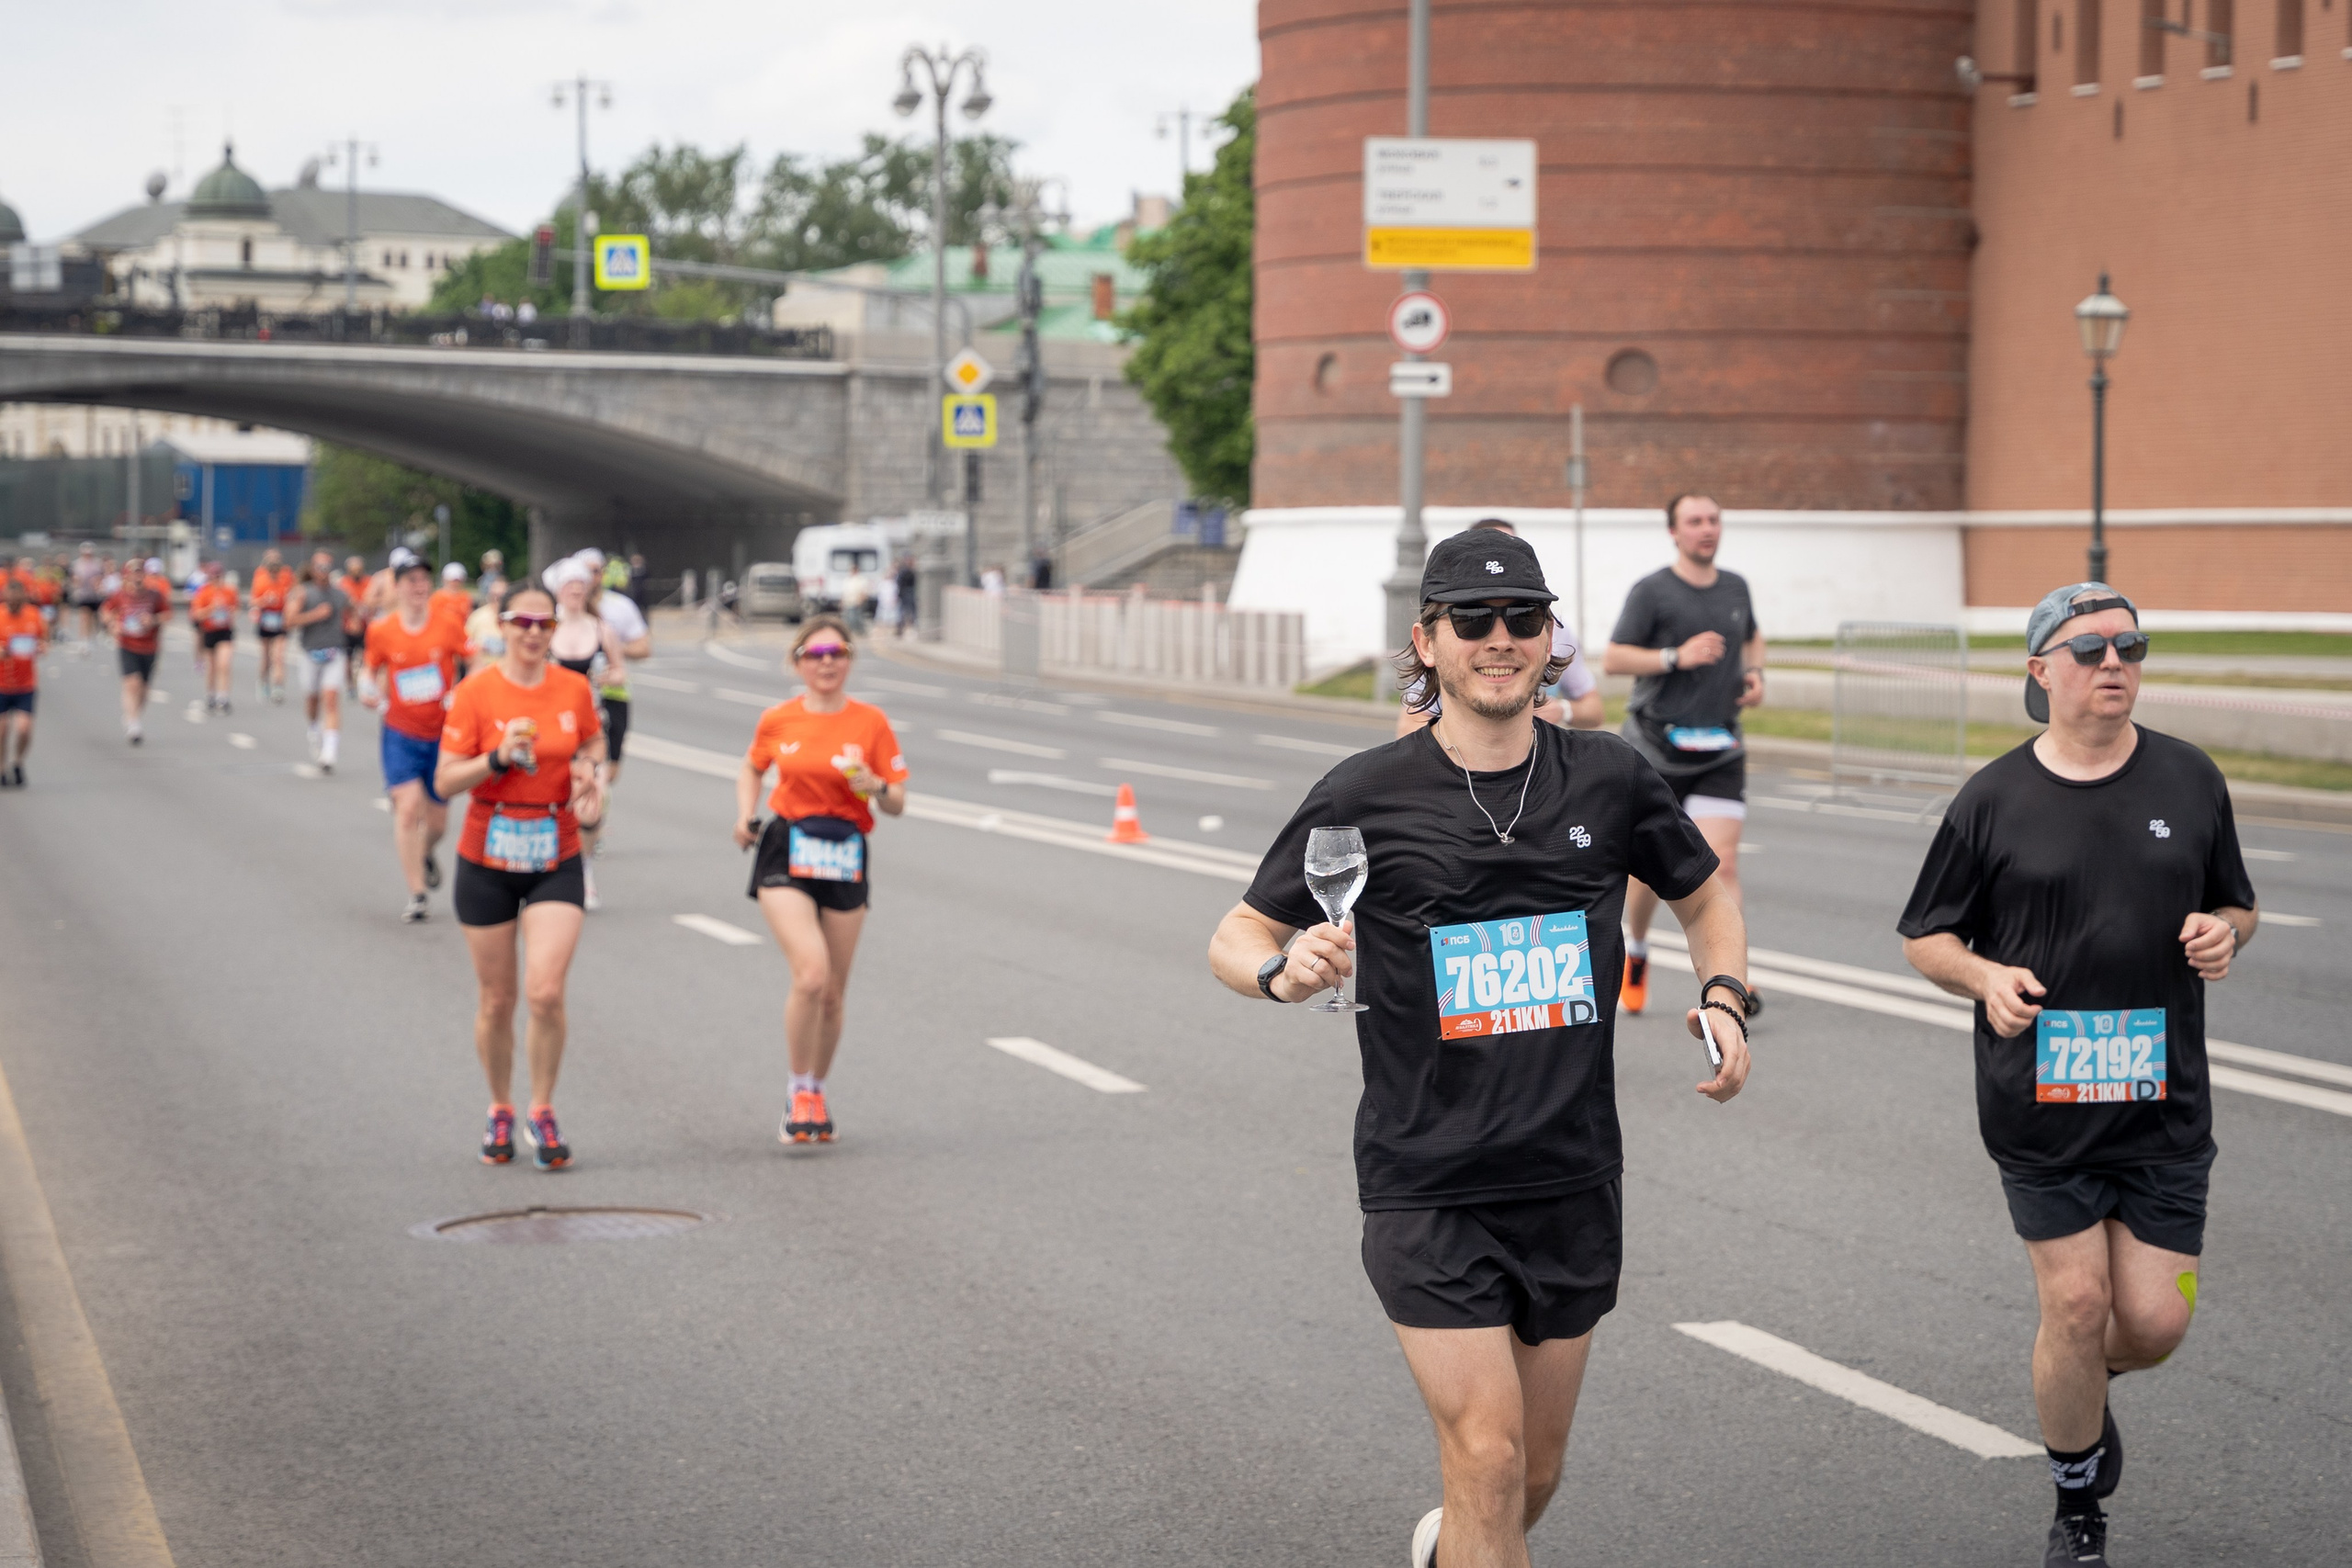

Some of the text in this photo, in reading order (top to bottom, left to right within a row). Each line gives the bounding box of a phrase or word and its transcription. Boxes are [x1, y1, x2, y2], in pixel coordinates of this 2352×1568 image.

[1450, 935, 1470, 945] ПСБ
[1498, 921, 1524, 947] 10
[1445, 942, 1585, 1010] 76202
[1569, 999, 1595, 1026] D
[2093, 1014, 2114, 1034] 10
[2049, 1034, 2154, 1080] 72192
[2136, 1080, 2157, 1100] D
